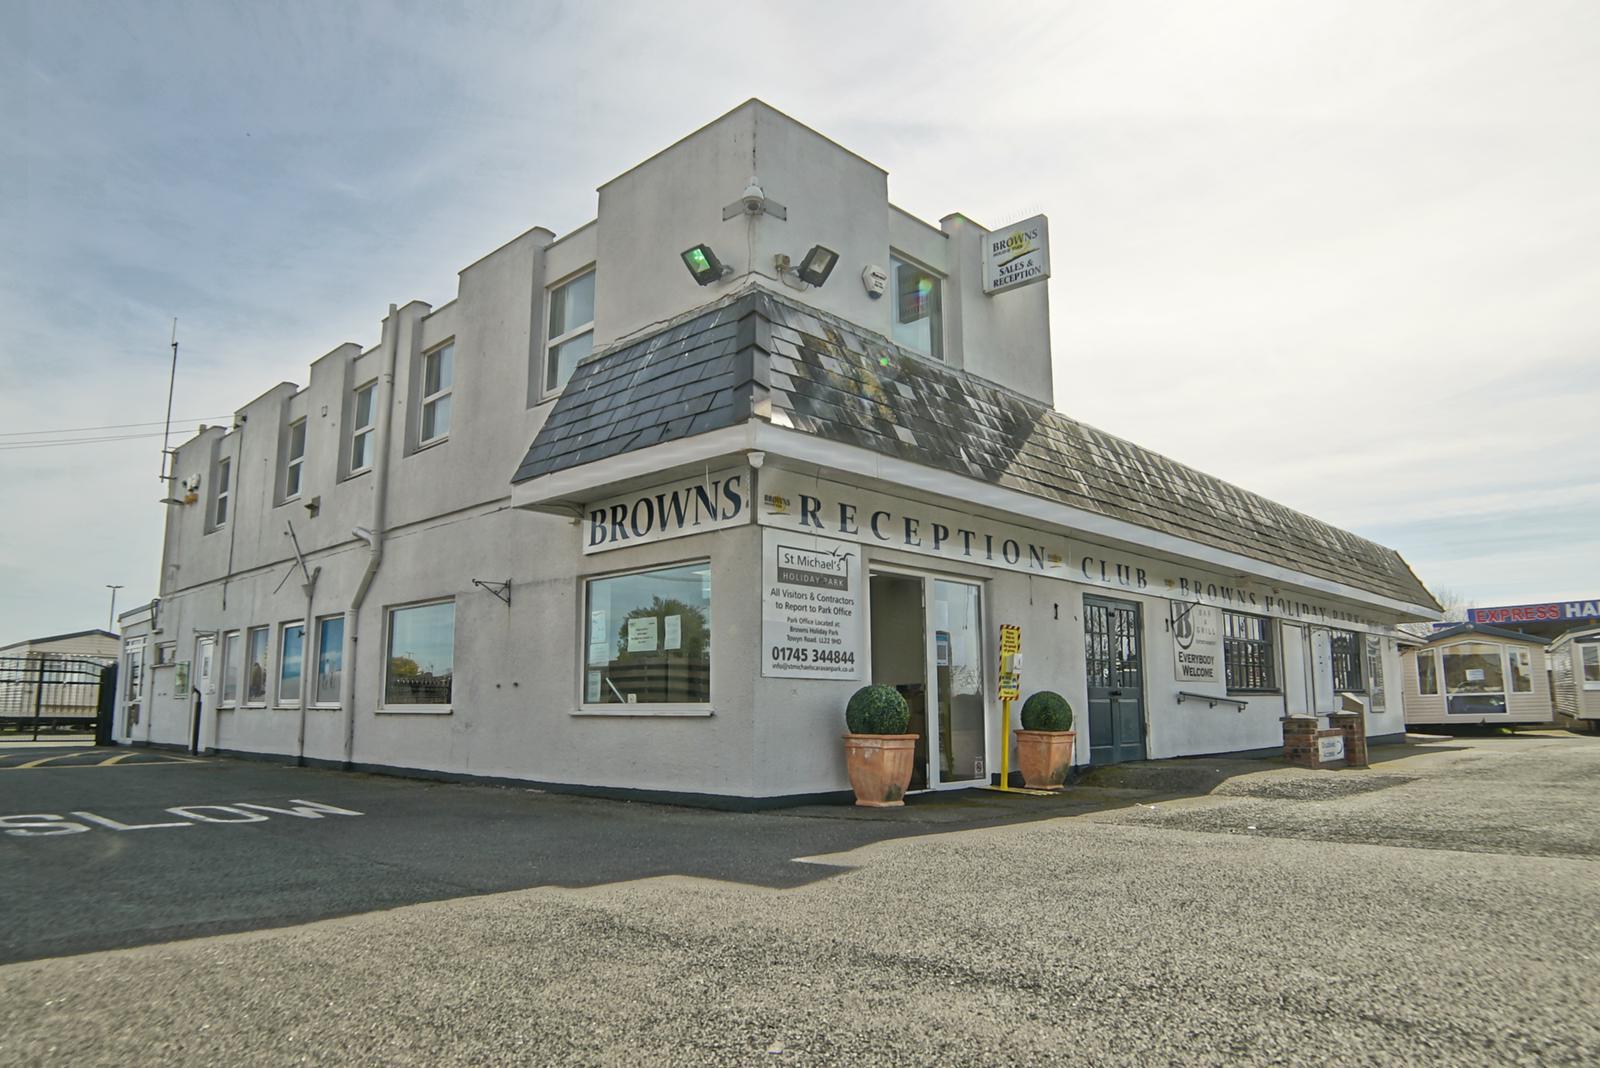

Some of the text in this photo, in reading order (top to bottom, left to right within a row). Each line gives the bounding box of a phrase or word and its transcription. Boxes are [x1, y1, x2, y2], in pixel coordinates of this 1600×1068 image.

[993, 229, 1038, 252] BROWNS
[993, 265, 1041, 288] RECEPTION
[999, 259, 1033, 276] SALES &
[588, 475, 742, 547] BROWNS
[784, 553, 841, 571] St Michael's
[798, 494, 1046, 570] RECEPTION
[1081, 556, 1147, 589] CLUB
[1179, 577, 1256, 606] BROWNS
[1265, 595, 1327, 621] HOLIDAY
[783, 572, 844, 587] HOLIDAY PARK
[770, 588, 855, 606] All Visitors & Contractors
[775, 601, 852, 617] to Report to Park Office
[1475, 602, 1600, 623] EXPRESS HA
[772, 646, 855, 664] 01745 344844
[1178, 651, 1215, 665] EVERYBODY
[1182, 664, 1214, 678] WELCOME
[0, 799, 366, 836] SLOW
